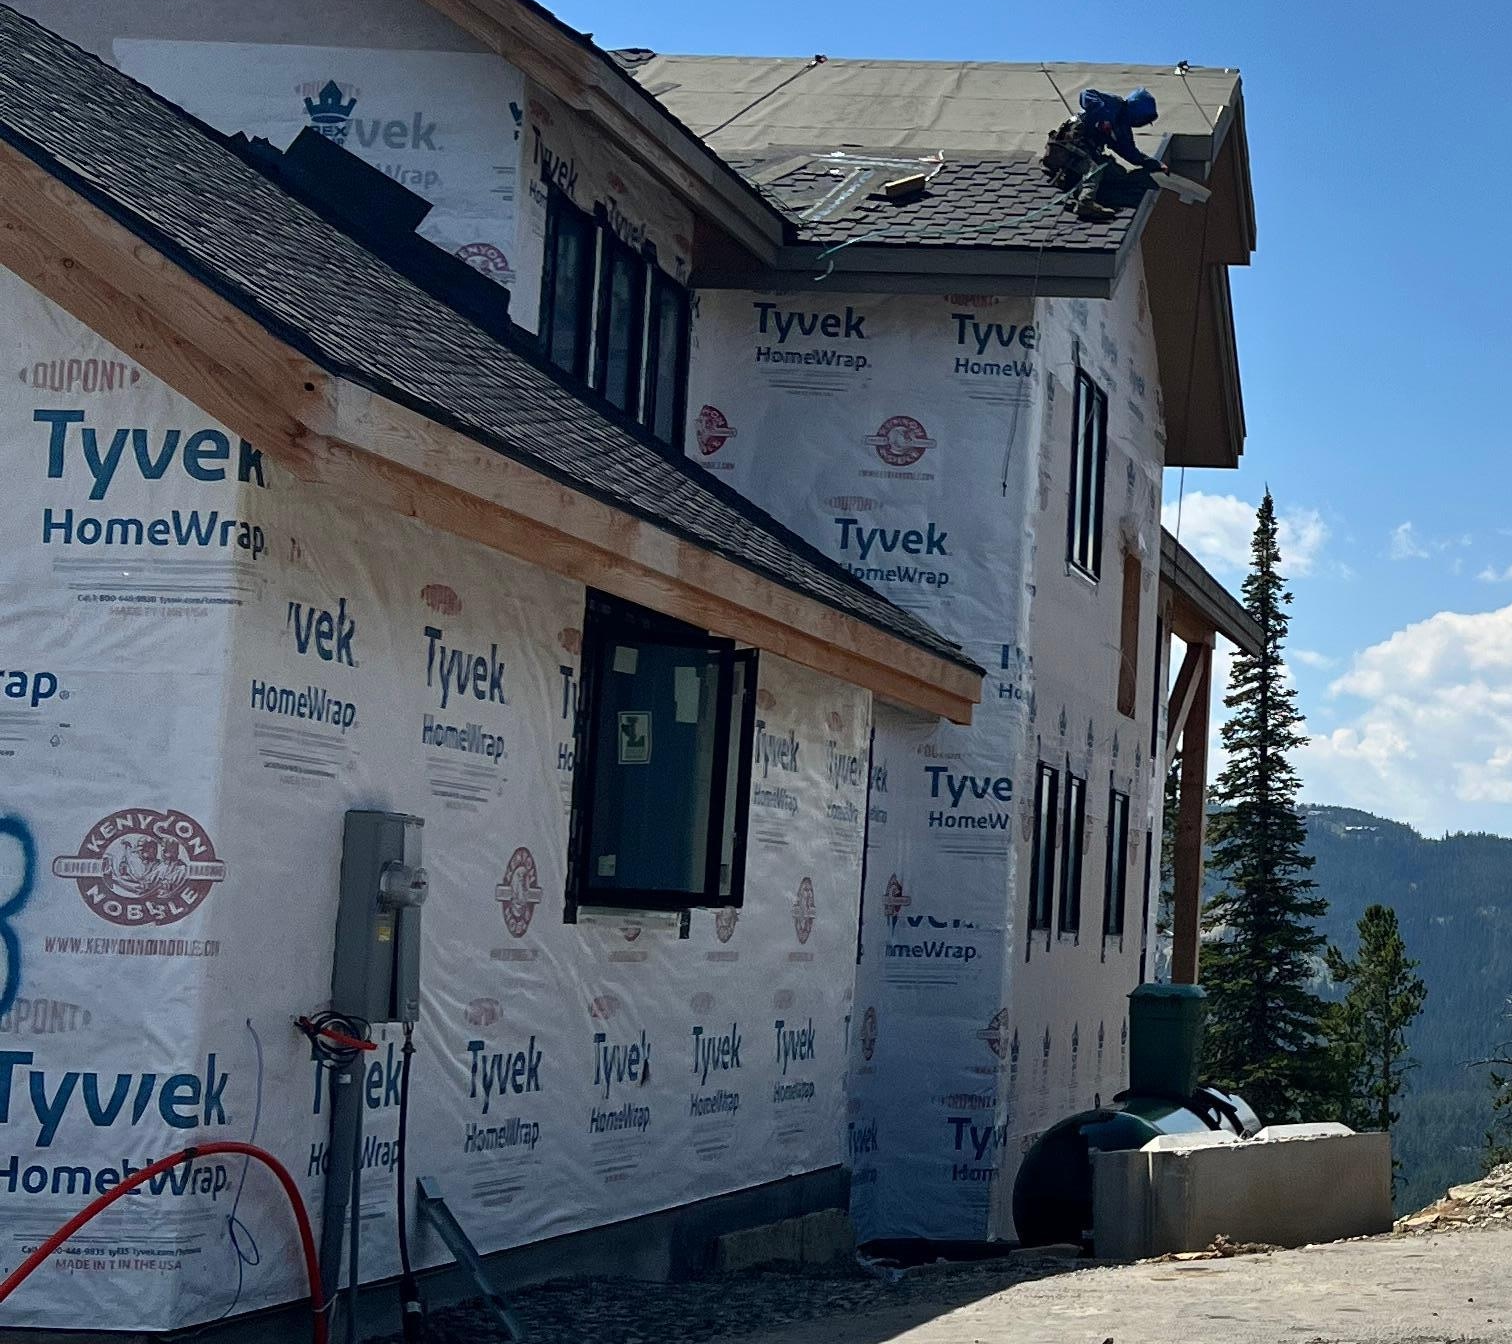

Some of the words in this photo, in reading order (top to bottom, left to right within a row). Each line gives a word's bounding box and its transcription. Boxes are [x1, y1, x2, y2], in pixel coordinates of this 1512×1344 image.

[346, 111, 437, 151] vek
[753, 302, 866, 344] Tyvek
[33, 358, 128, 392] DUPONT
[755, 345, 868, 371] HomeWrap
[954, 357, 1034, 378] HomeW
[33, 409, 265, 501] Tyvek
[43, 508, 265, 561] HomeWrap
[834, 517, 949, 561] Tyvek
[287, 598, 356, 668] vek
[424, 625, 506, 709] Tyvek
[251, 679, 357, 735] HomeWrap
[421, 713, 505, 764] HomeWrap
[925, 765, 1013, 807] Tyve
[928, 810, 1010, 830] HomeW
[885, 940, 977, 963] meWrap
[693, 1022, 742, 1086] Tyvek
[774, 1017, 816, 1075] Tyvek
[311, 1042, 402, 1115] Tek
[466, 1035, 543, 1115] Tyvek
[307, 1135, 401, 1178] HoWrap
[463, 1117, 541, 1154] HomeWrap
